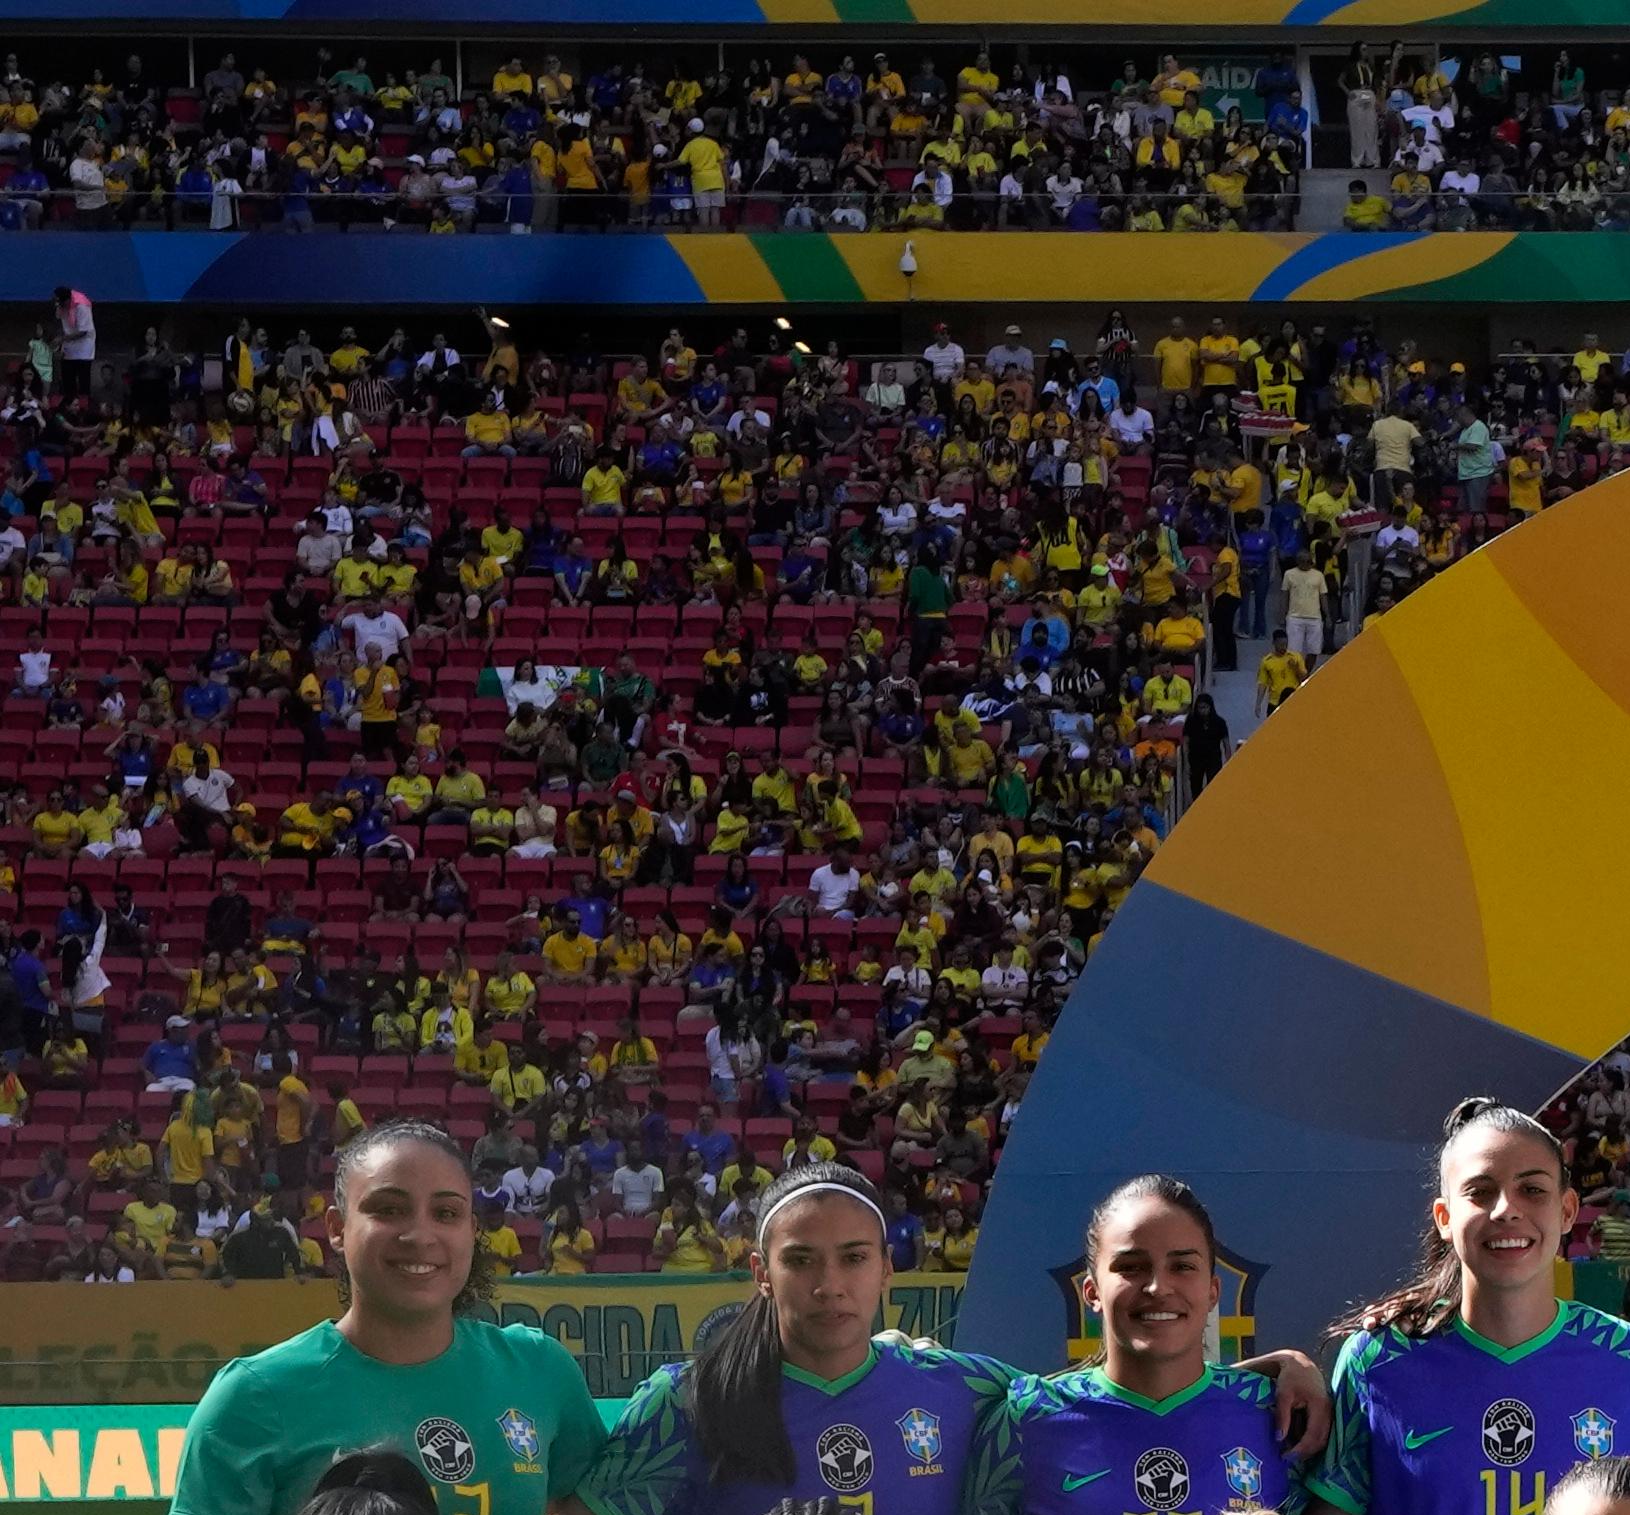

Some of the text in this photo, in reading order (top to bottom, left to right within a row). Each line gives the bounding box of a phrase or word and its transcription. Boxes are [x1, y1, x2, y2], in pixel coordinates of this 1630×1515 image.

[472, 1302, 684, 1398] CIDA
[0, 1427, 187, 1498] NA
[909, 1465, 944, 1476] BRASIL
